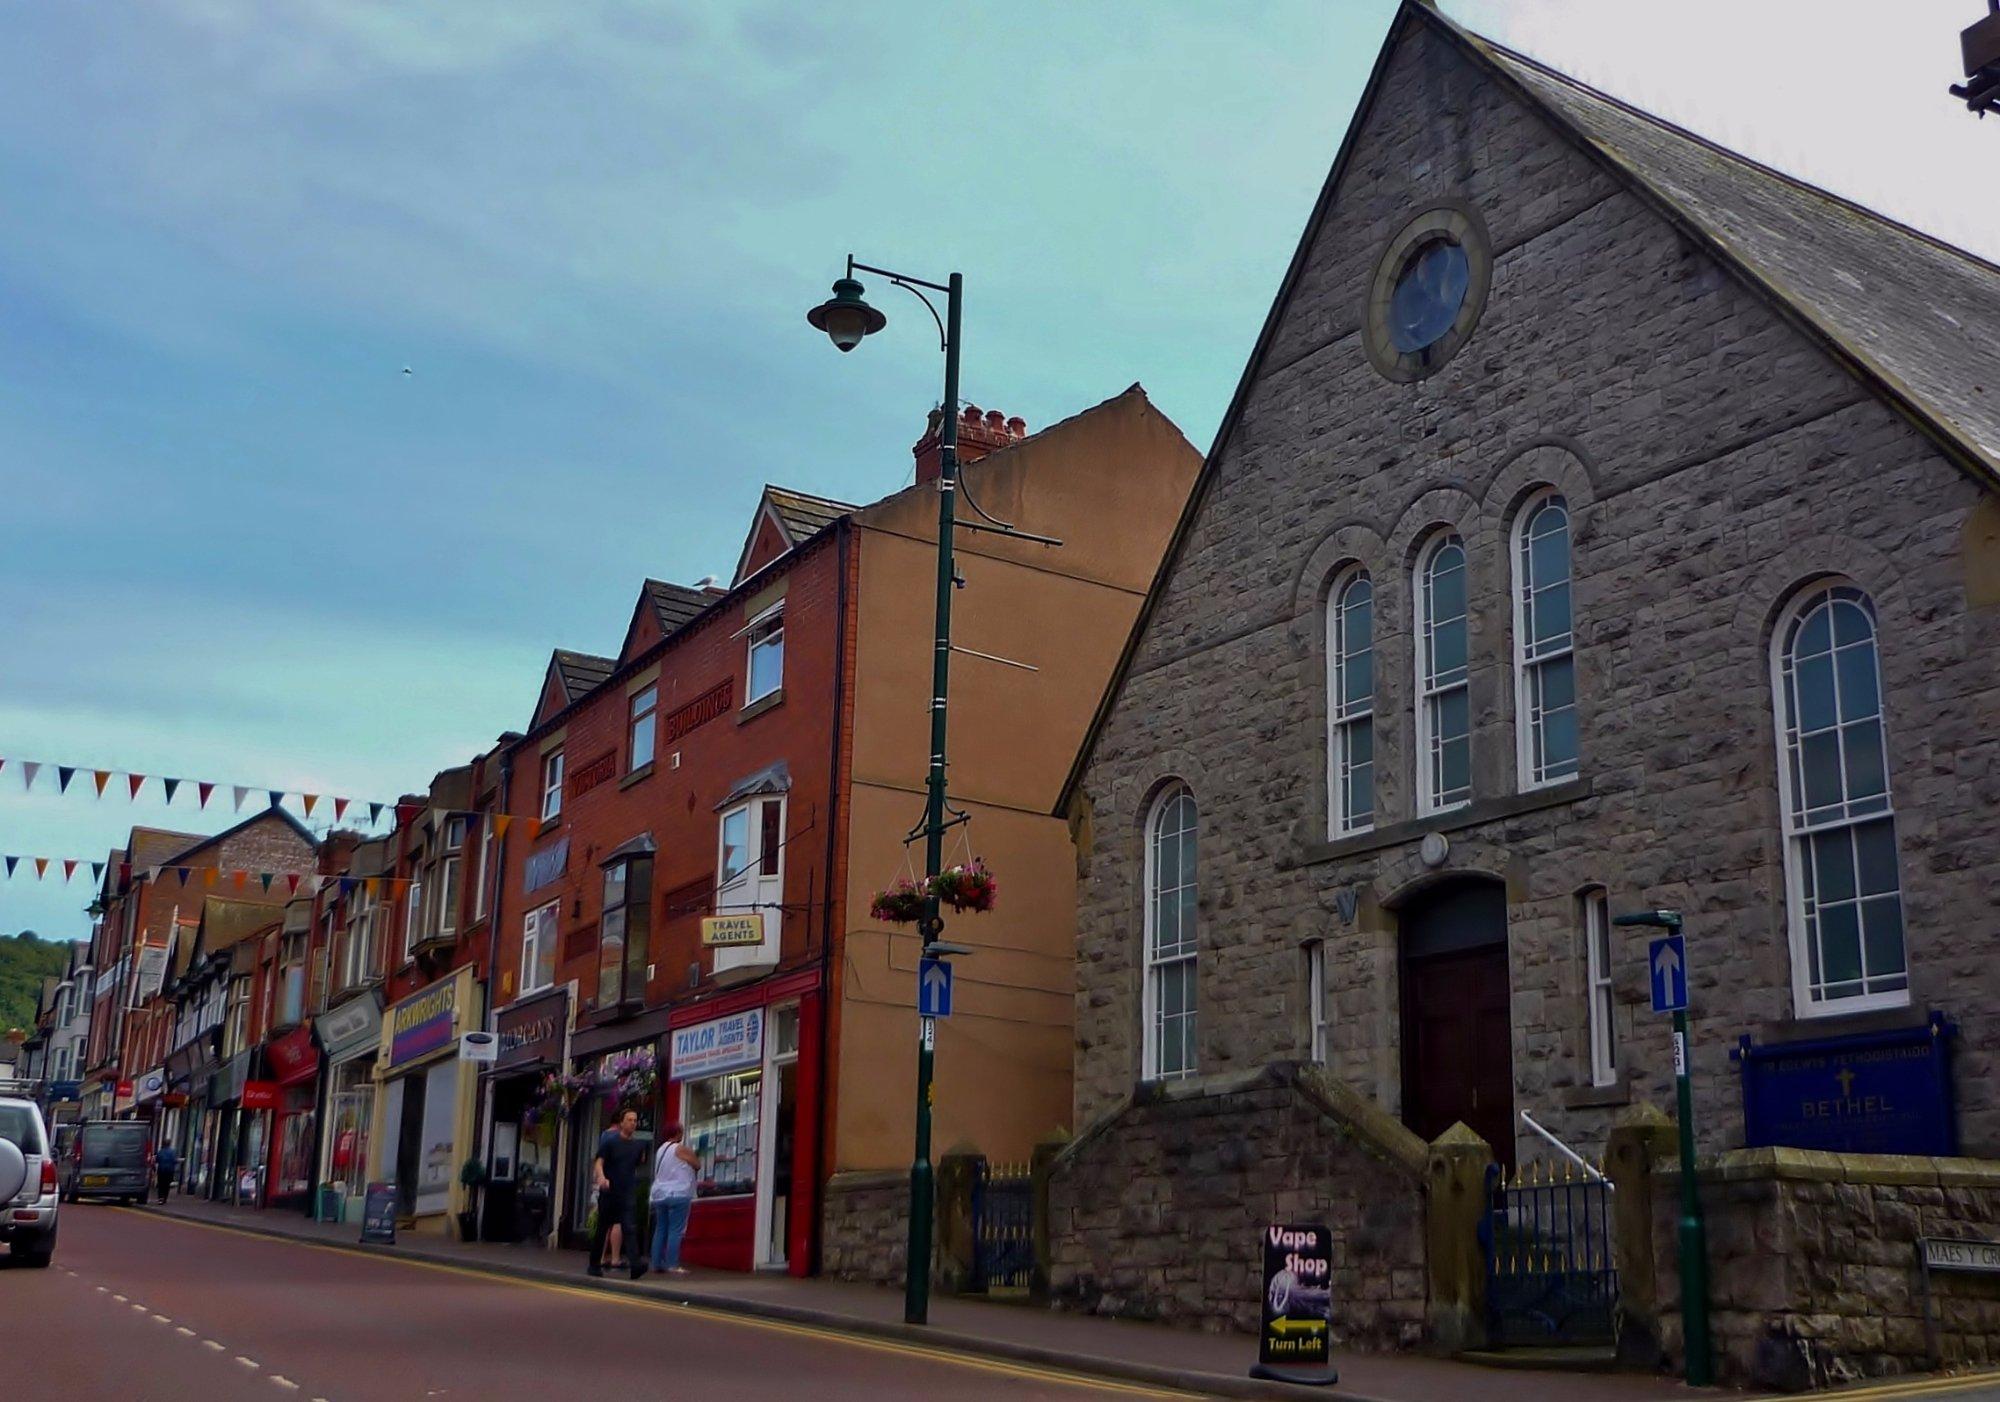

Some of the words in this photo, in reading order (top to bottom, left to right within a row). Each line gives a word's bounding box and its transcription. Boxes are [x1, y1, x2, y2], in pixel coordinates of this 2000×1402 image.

[667, 684, 732, 741] BUILDINGS
[711, 930, 755, 940] AGENTS
[712, 920, 752, 930] TRAVEL
[394, 982, 453, 1035] ARKWRIGHTS
[719, 1017, 744, 1033] TRAVEL
[677, 1027, 715, 1055] TAYLOR
[718, 1031, 744, 1045] AGENTS
[1801, 1095, 1895, 1118] BETHEL
[1269, 1226, 1317, 1250] Vape
[1928, 1242, 1962, 1263] MAES
[1967, 1245, 1976, 1263] Y
[1285, 1253, 1328, 1276] Shop
[1268, 1337, 1296, 1351] Turn
[1299, 1336, 1322, 1350] Left
